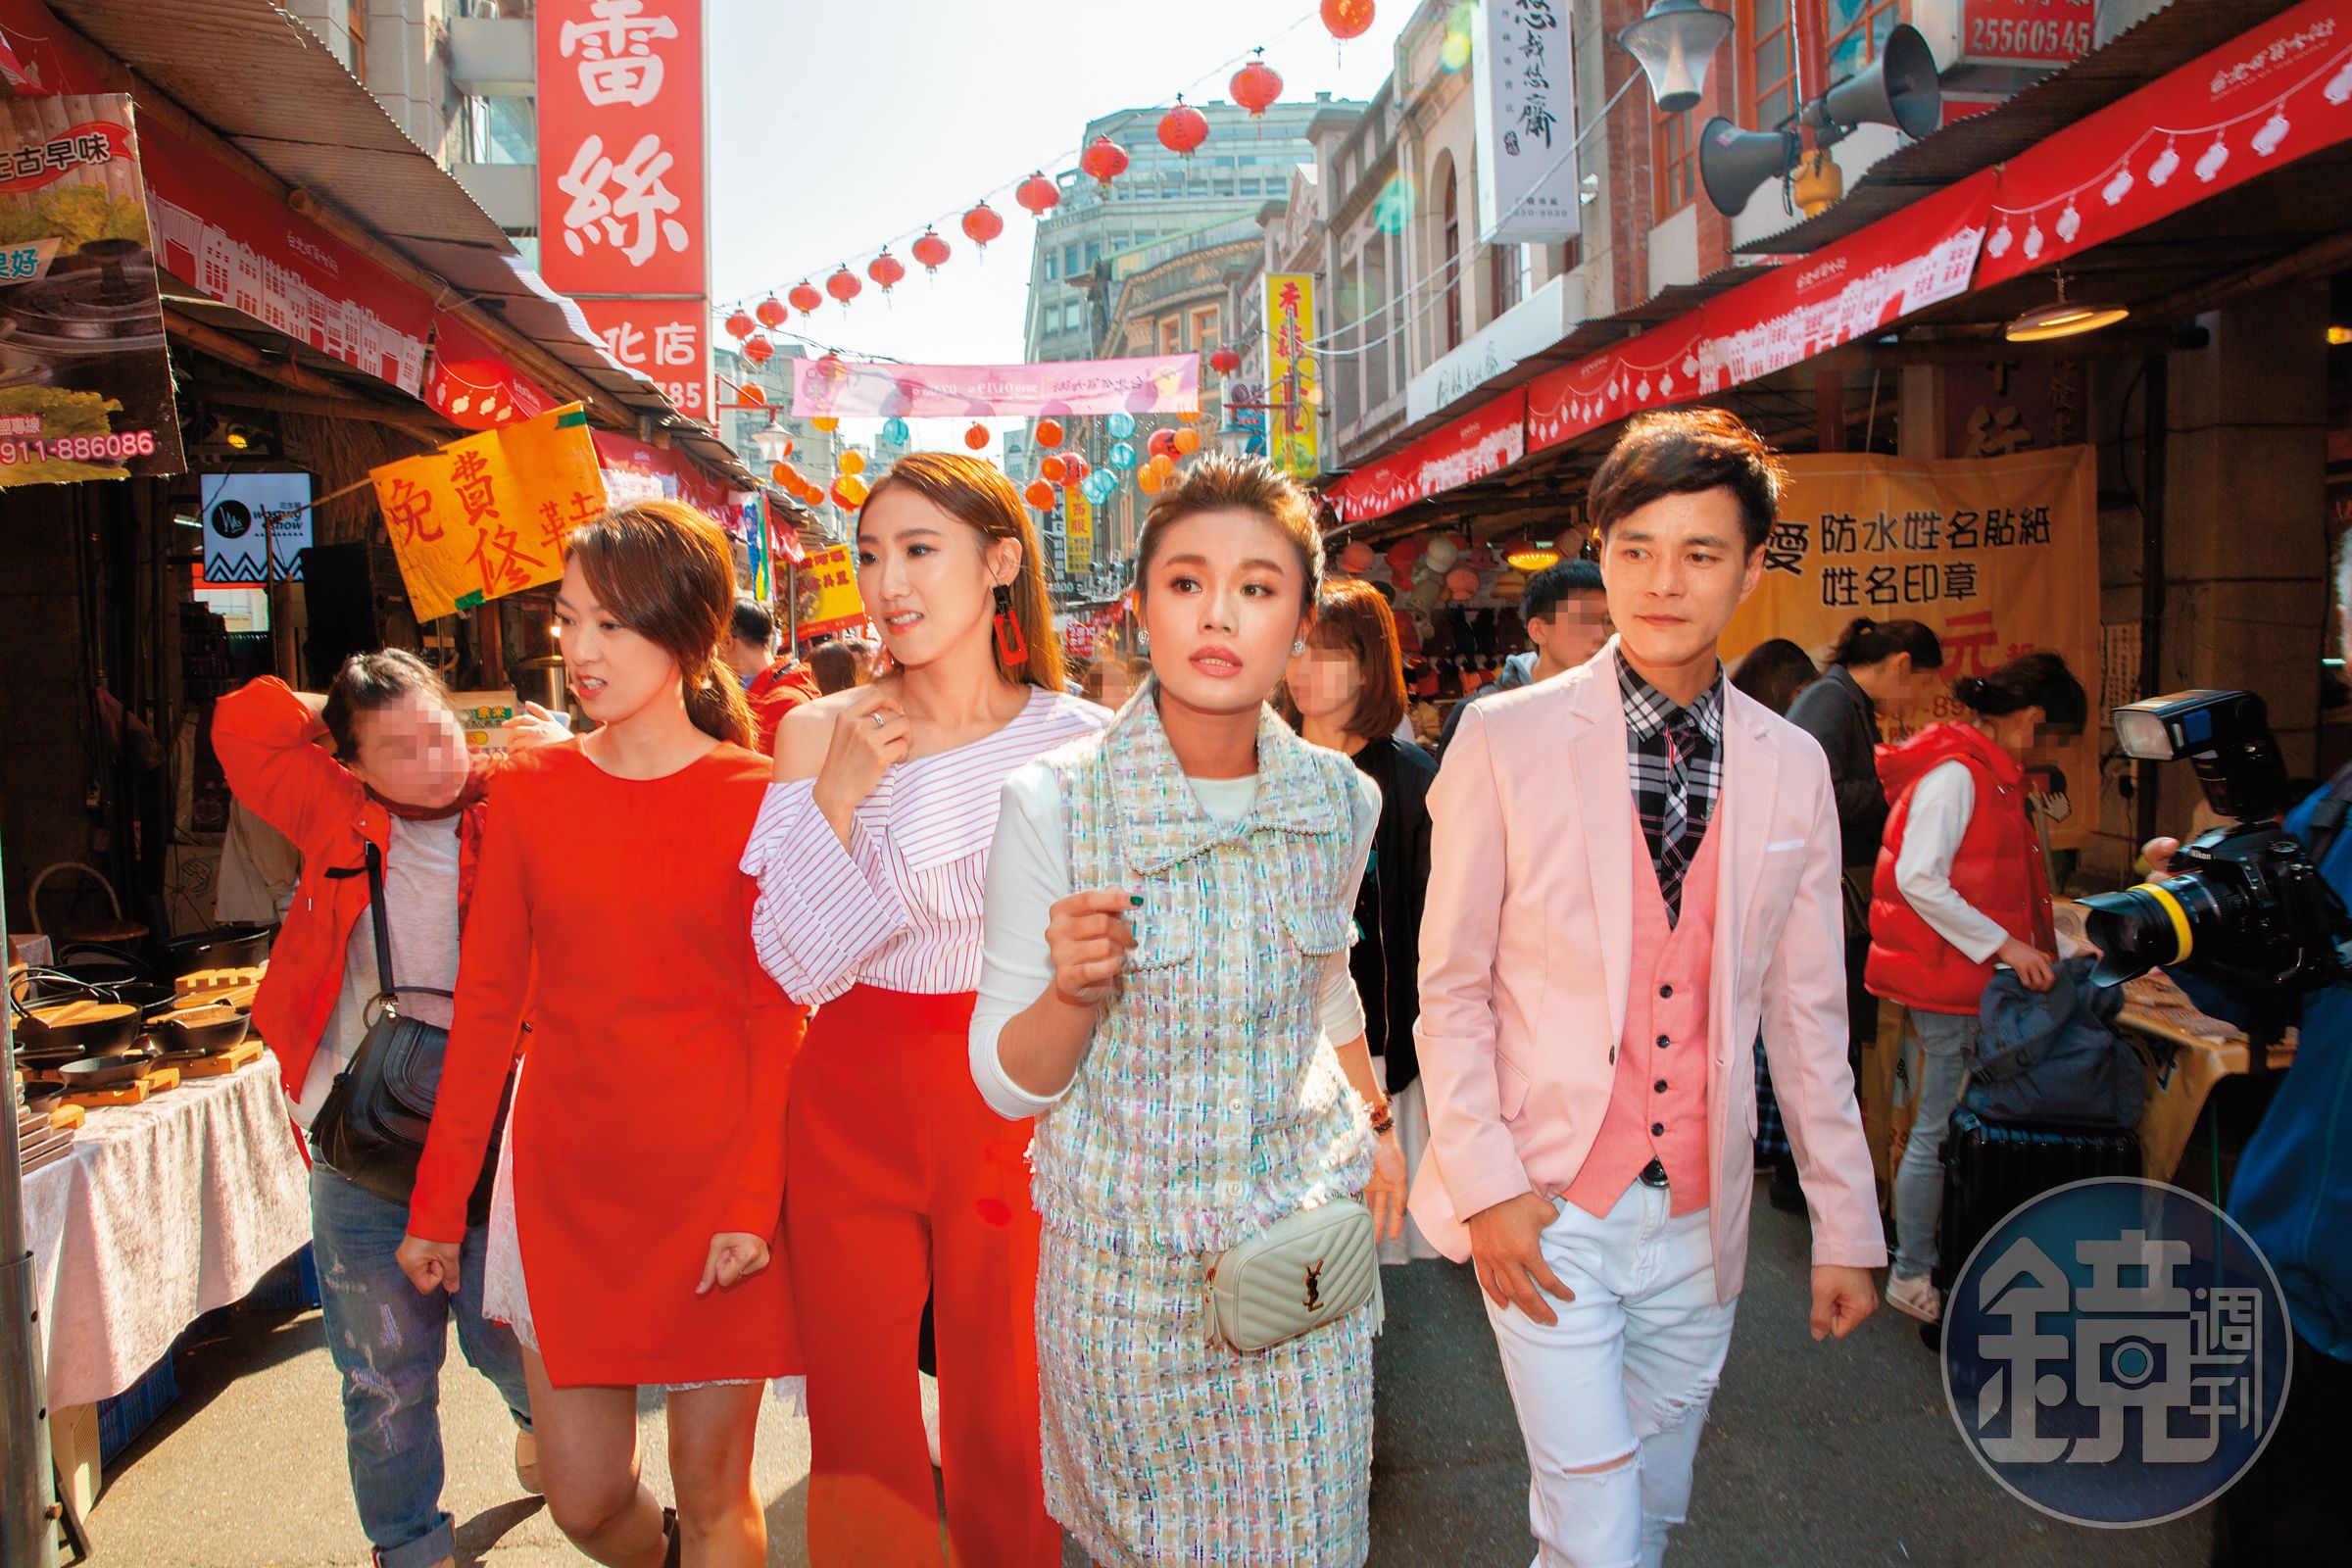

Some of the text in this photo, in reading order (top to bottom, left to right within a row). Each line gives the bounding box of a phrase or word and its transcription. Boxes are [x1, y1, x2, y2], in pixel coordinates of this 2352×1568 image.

[1973, 18, 2090, 56] 25560545
[1820, 506, 2051, 555] 防水姓名貼紙
[1821, 562, 1978, 608] 姓名印章
[2189, 849, 2212, 860] Nikon
